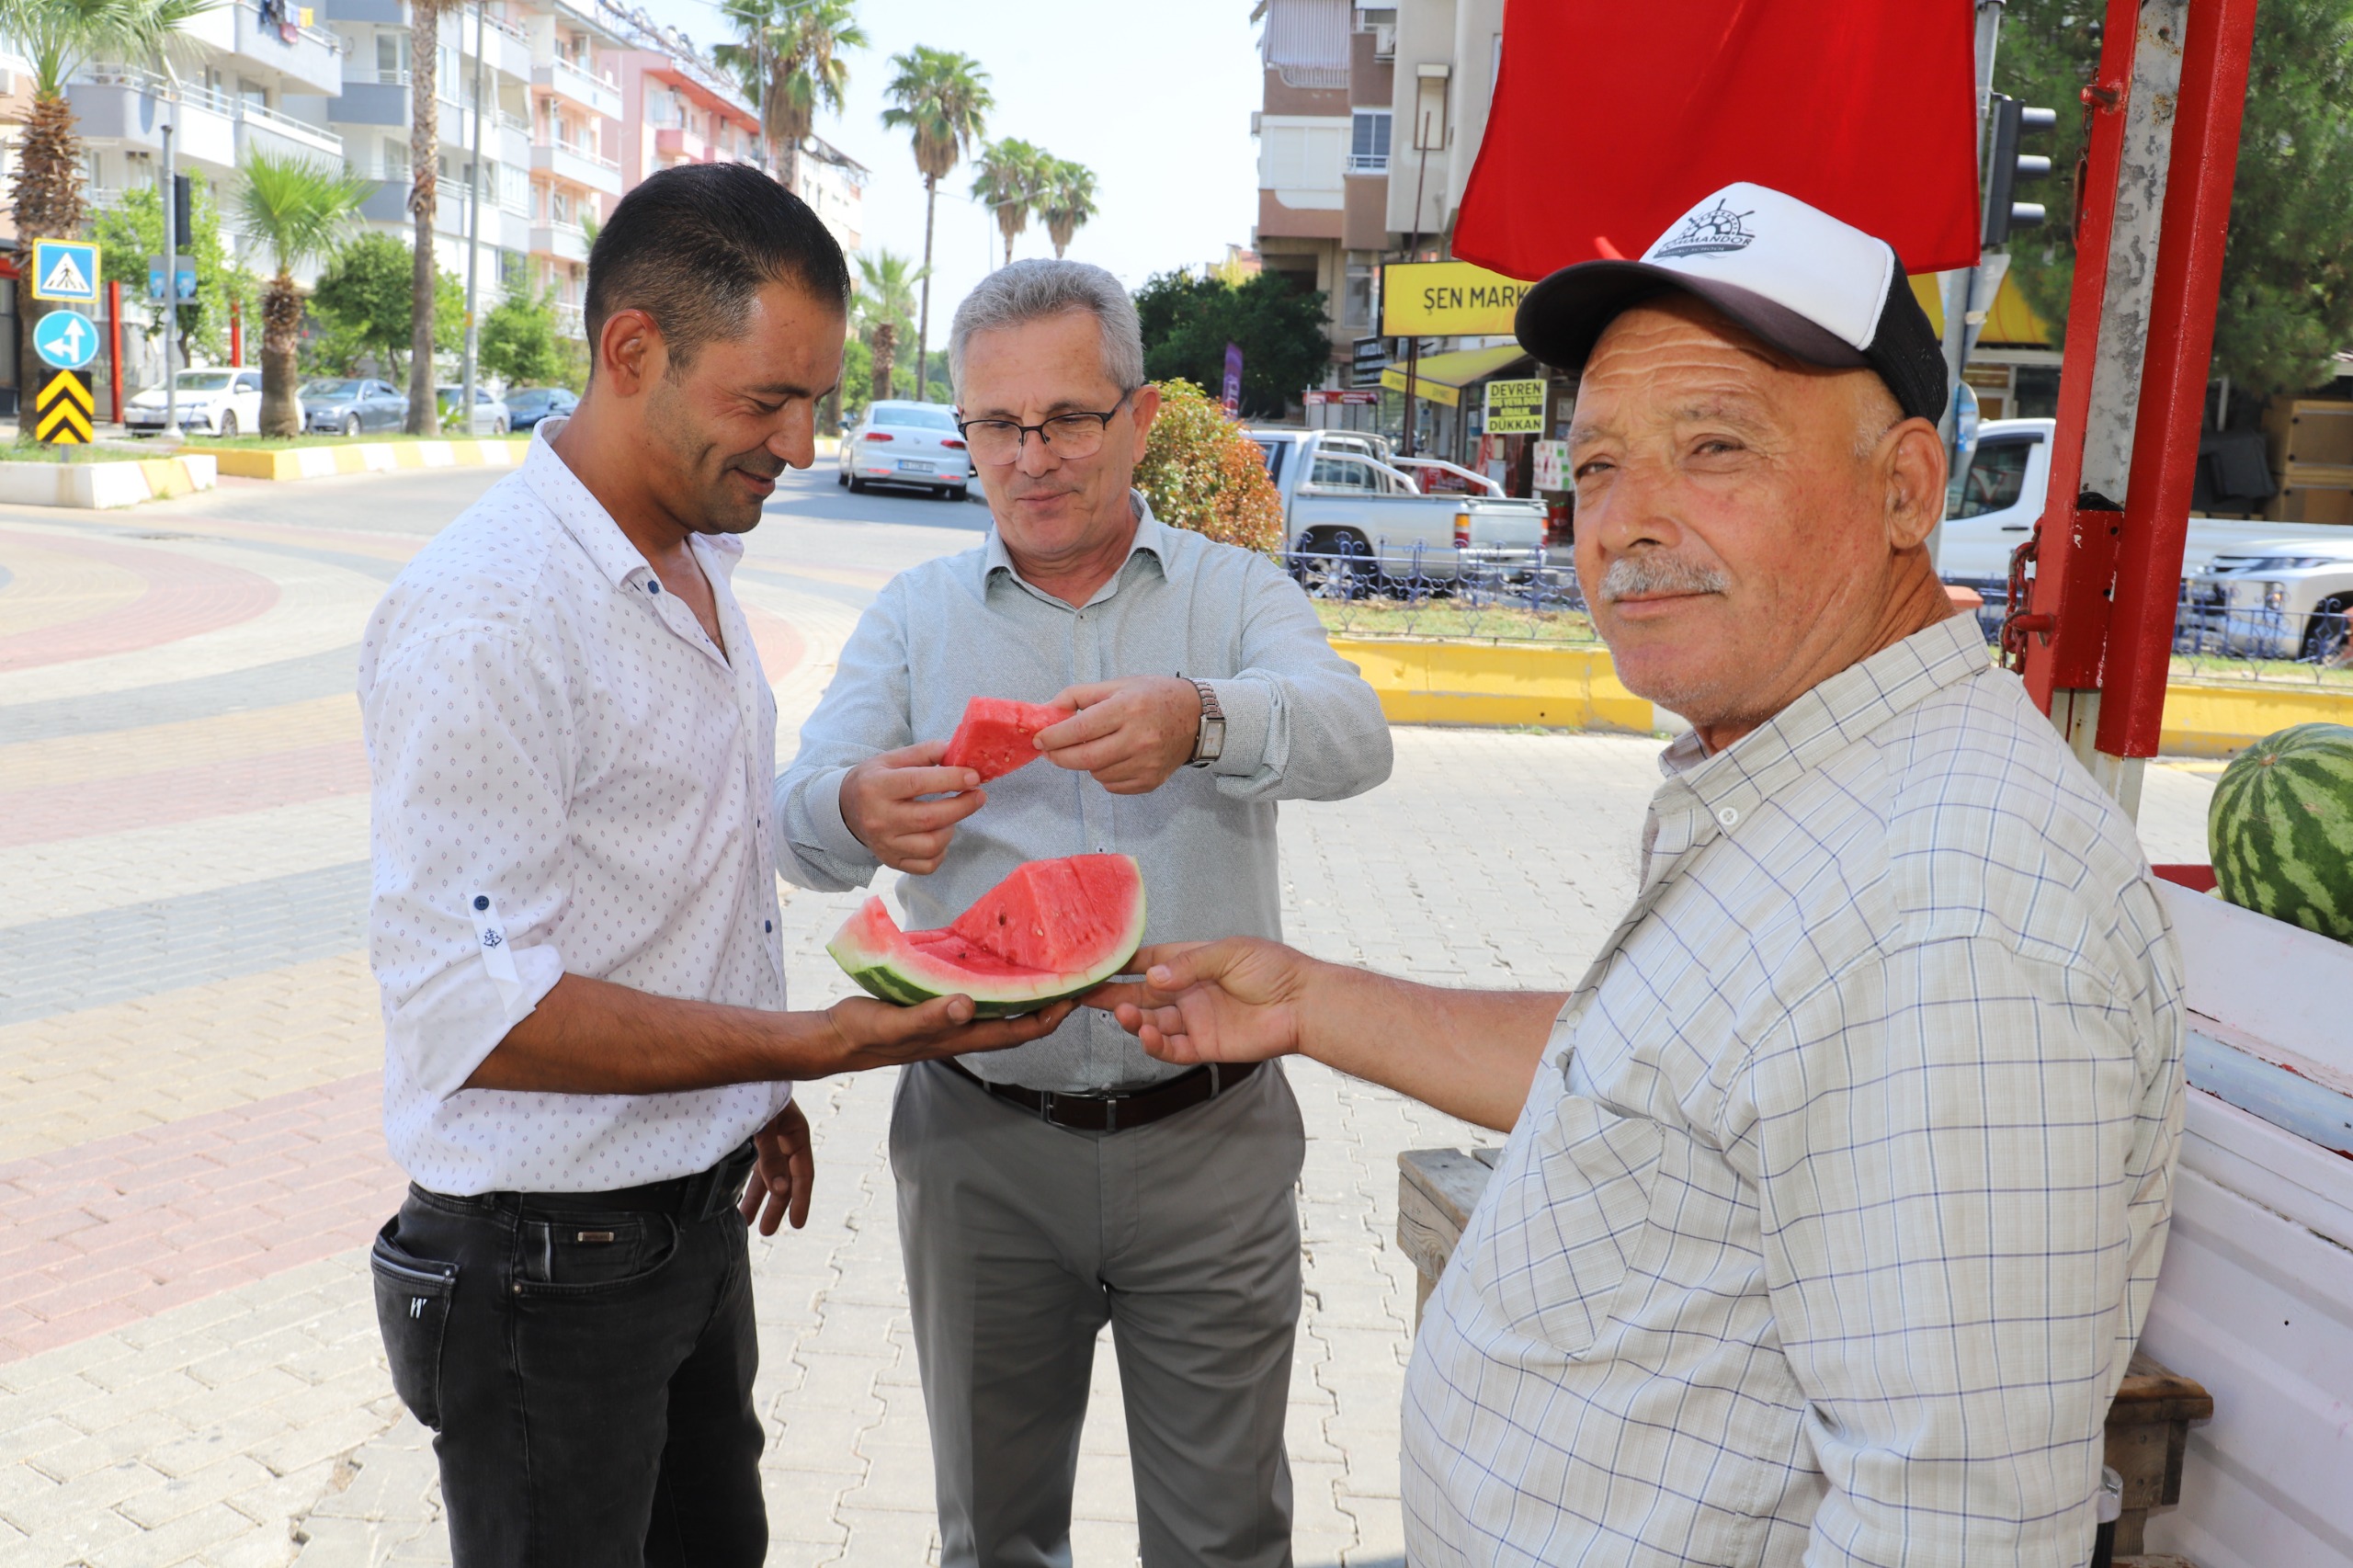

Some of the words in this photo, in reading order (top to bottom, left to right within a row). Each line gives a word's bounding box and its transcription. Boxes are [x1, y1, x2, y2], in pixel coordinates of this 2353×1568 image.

[1423, 287, 1463, 316] ŞEN
[1470, 285, 1533, 309] MARK
[1491, 382, 1541, 396] DEVREN
[1490, 417, 1541, 431] DÜKKAN
